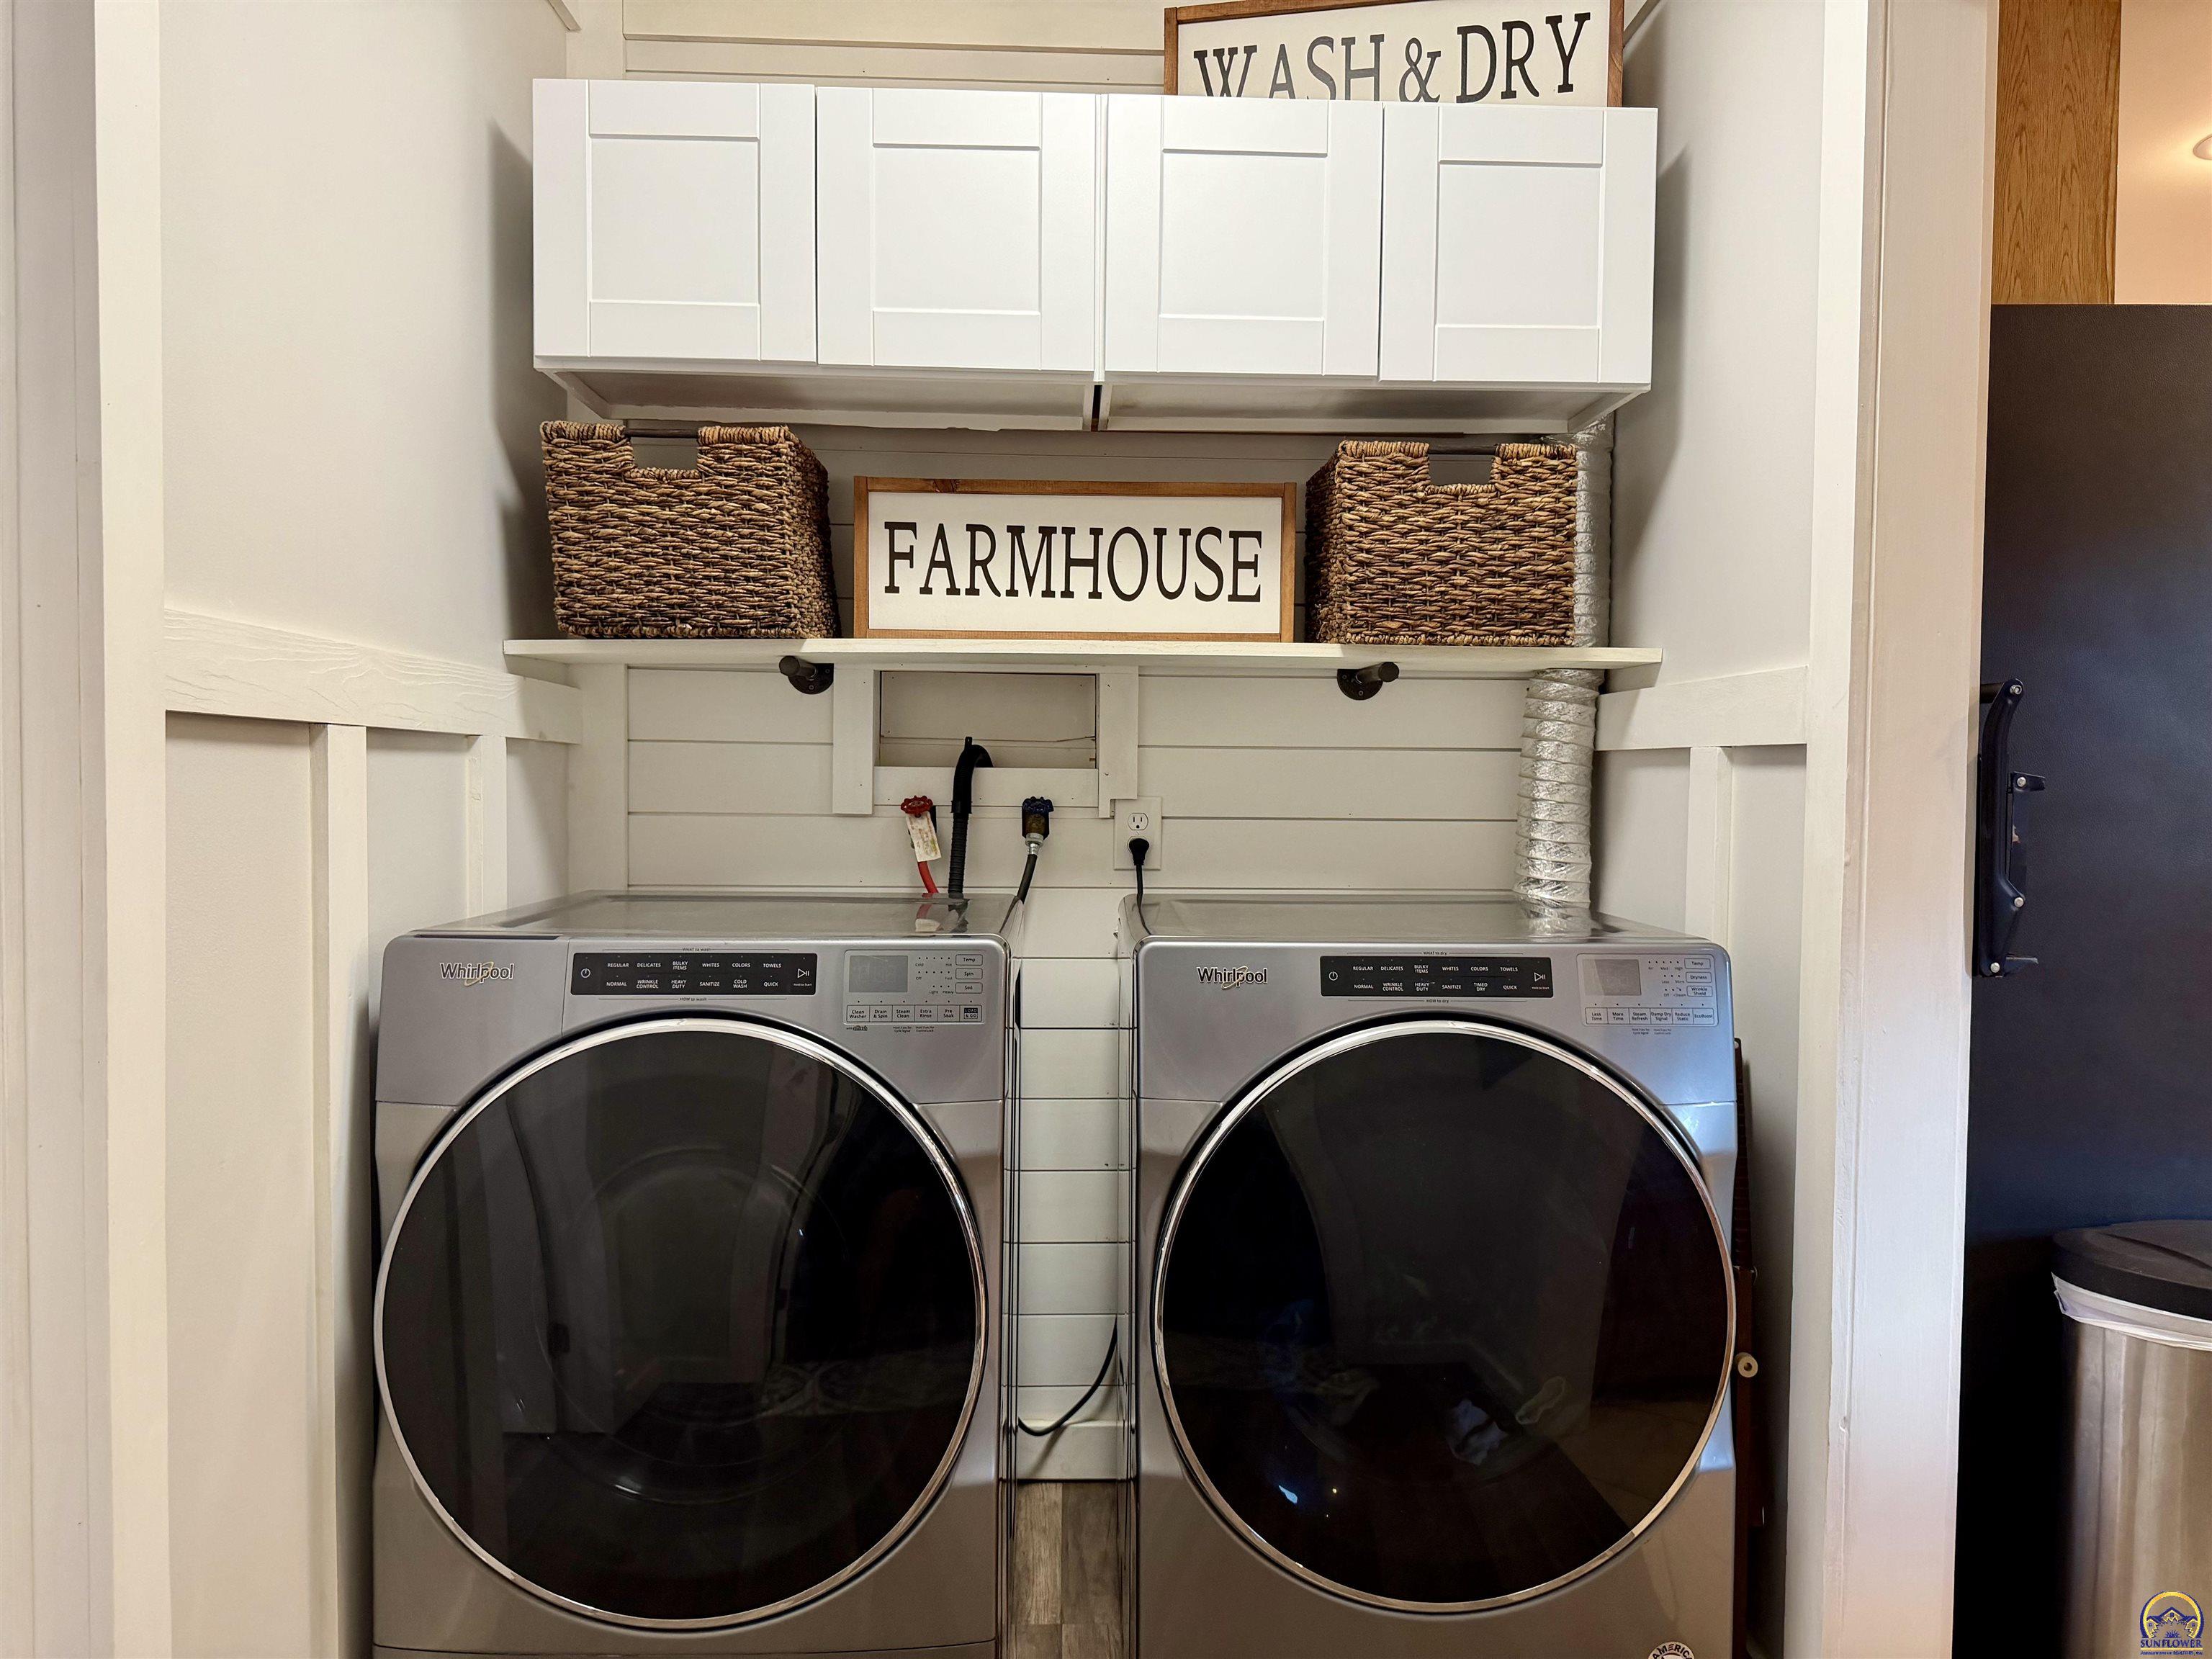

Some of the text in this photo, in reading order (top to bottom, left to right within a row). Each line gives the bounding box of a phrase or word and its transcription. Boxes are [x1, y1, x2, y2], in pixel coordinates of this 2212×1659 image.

[1194, 12, 1590, 103] WASH & DRY
[884, 521, 1262, 602] FARMHOUSE
[440, 963, 514, 984] Whirlpool
[1197, 967, 1267, 986] Whirlpool
[1652, 1644, 1693, 1659] AMERIC
